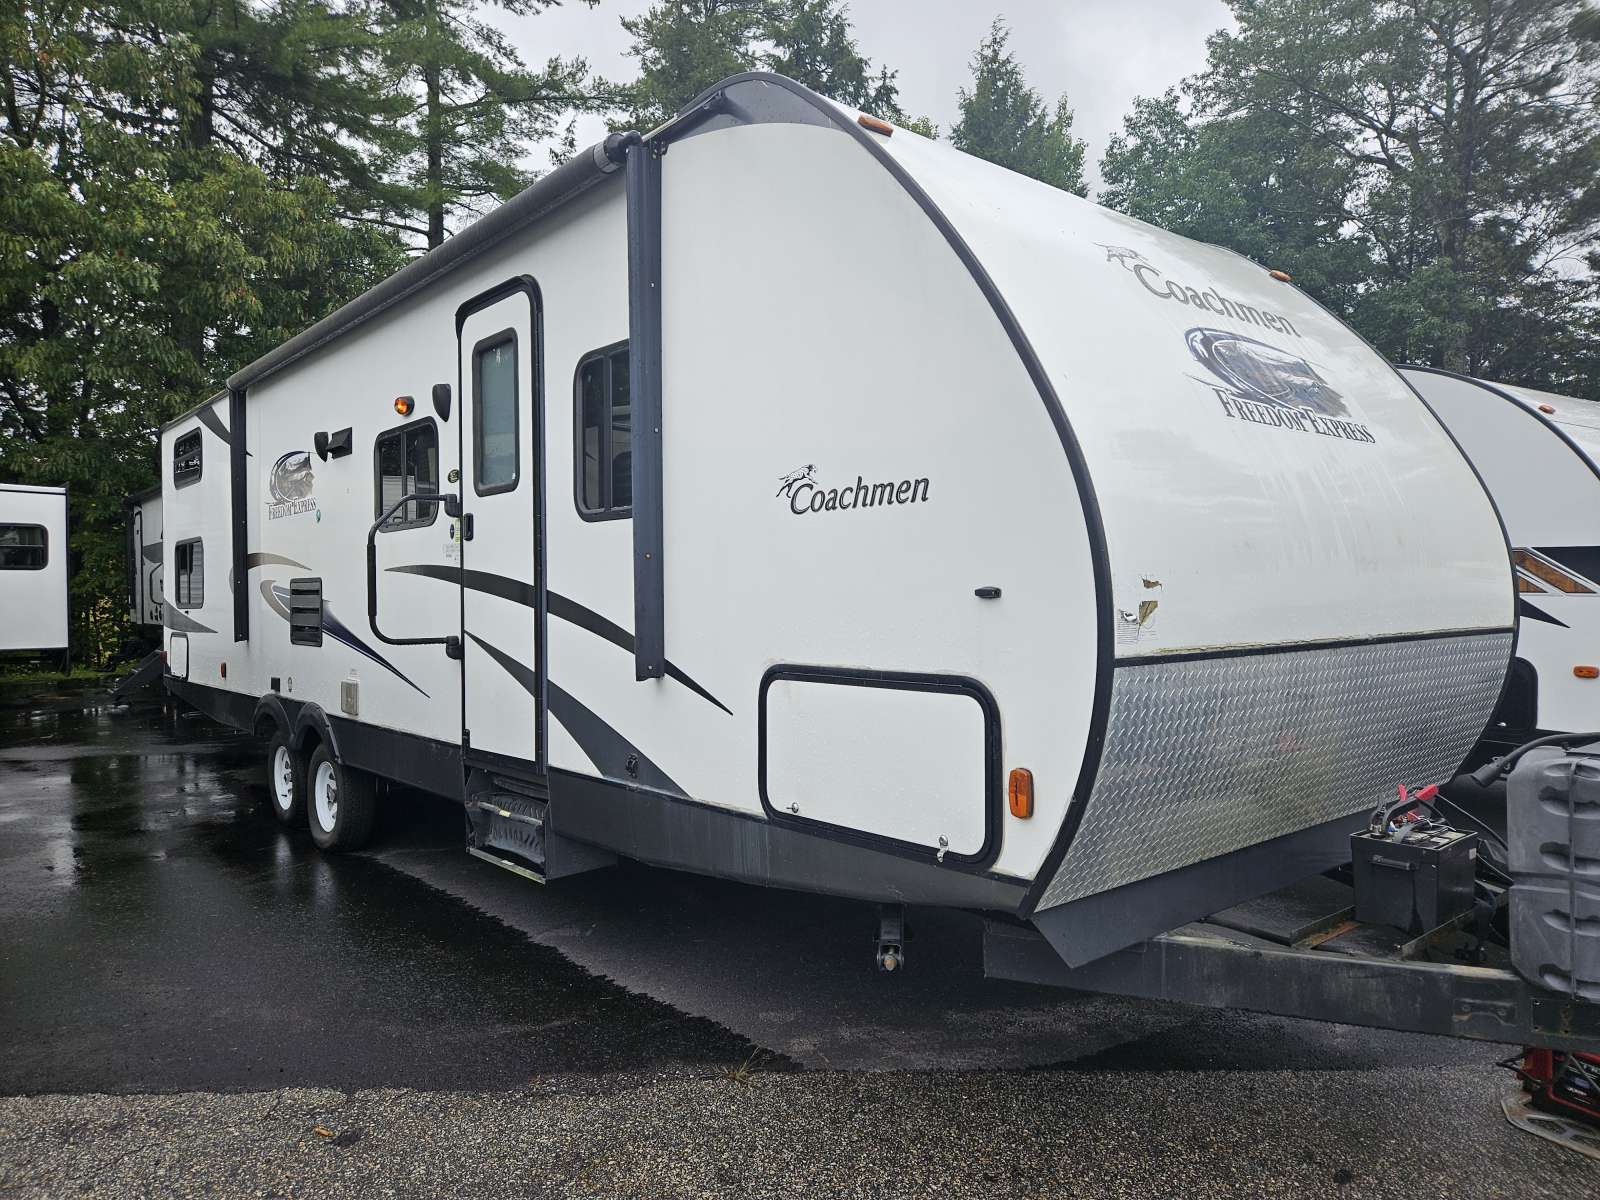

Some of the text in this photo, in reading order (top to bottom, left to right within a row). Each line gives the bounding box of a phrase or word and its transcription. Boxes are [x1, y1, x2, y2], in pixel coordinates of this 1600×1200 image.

[1133, 263, 1302, 338] Coachmen
[1211, 387, 1376, 444] FREEDOM EXPRESS
[790, 475, 930, 515] Coachmen
